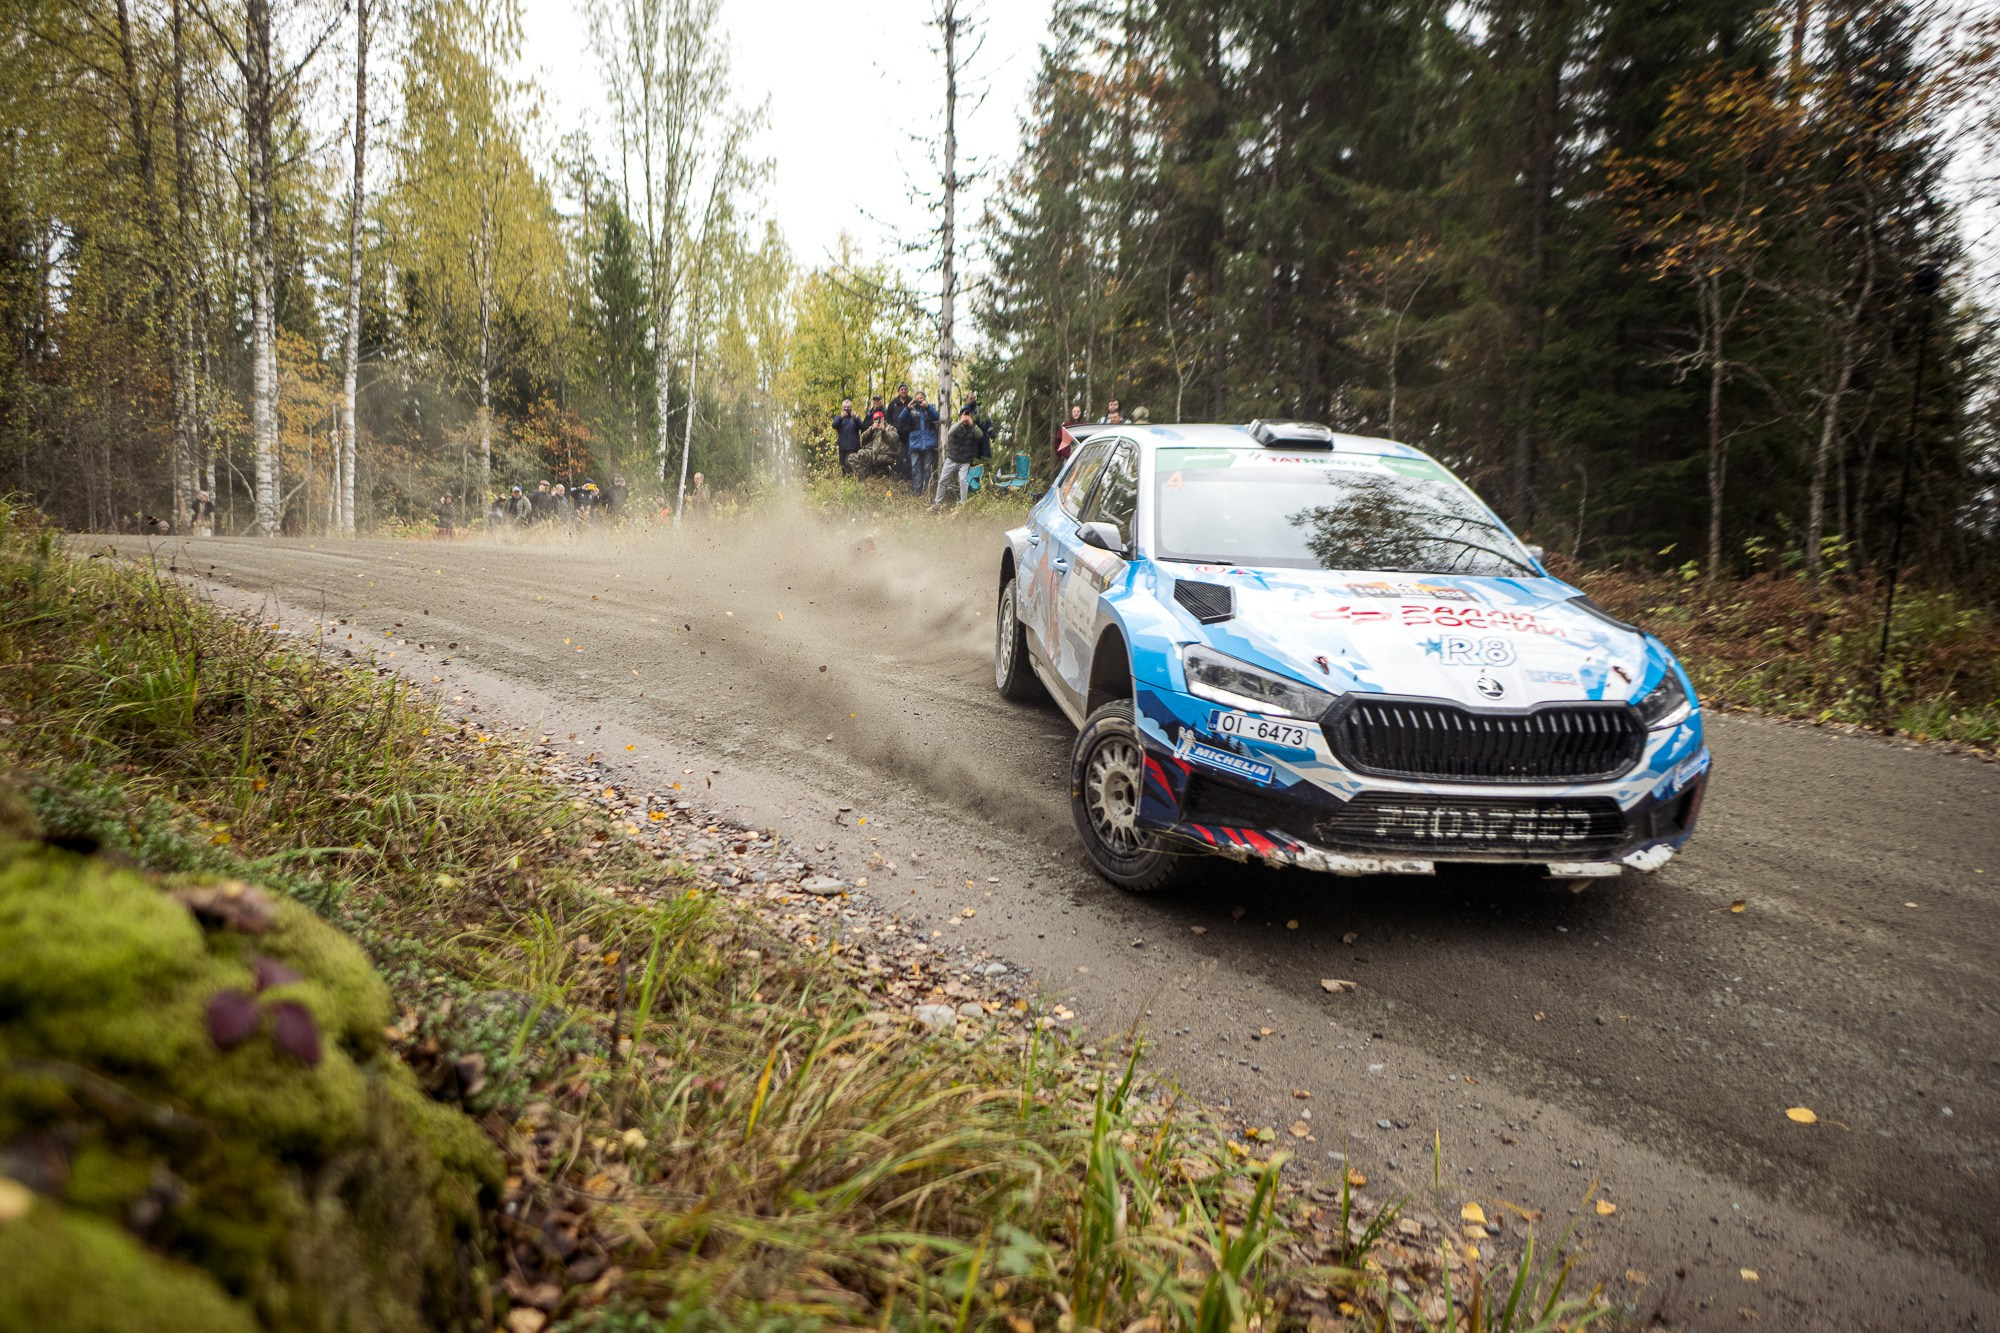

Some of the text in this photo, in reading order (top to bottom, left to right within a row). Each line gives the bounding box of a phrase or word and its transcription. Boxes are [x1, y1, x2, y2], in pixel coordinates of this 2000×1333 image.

[1166, 470, 1185, 491] 4
[1440, 634, 1517, 667] R8
[1194, 746, 1270, 777] MICHELIN
